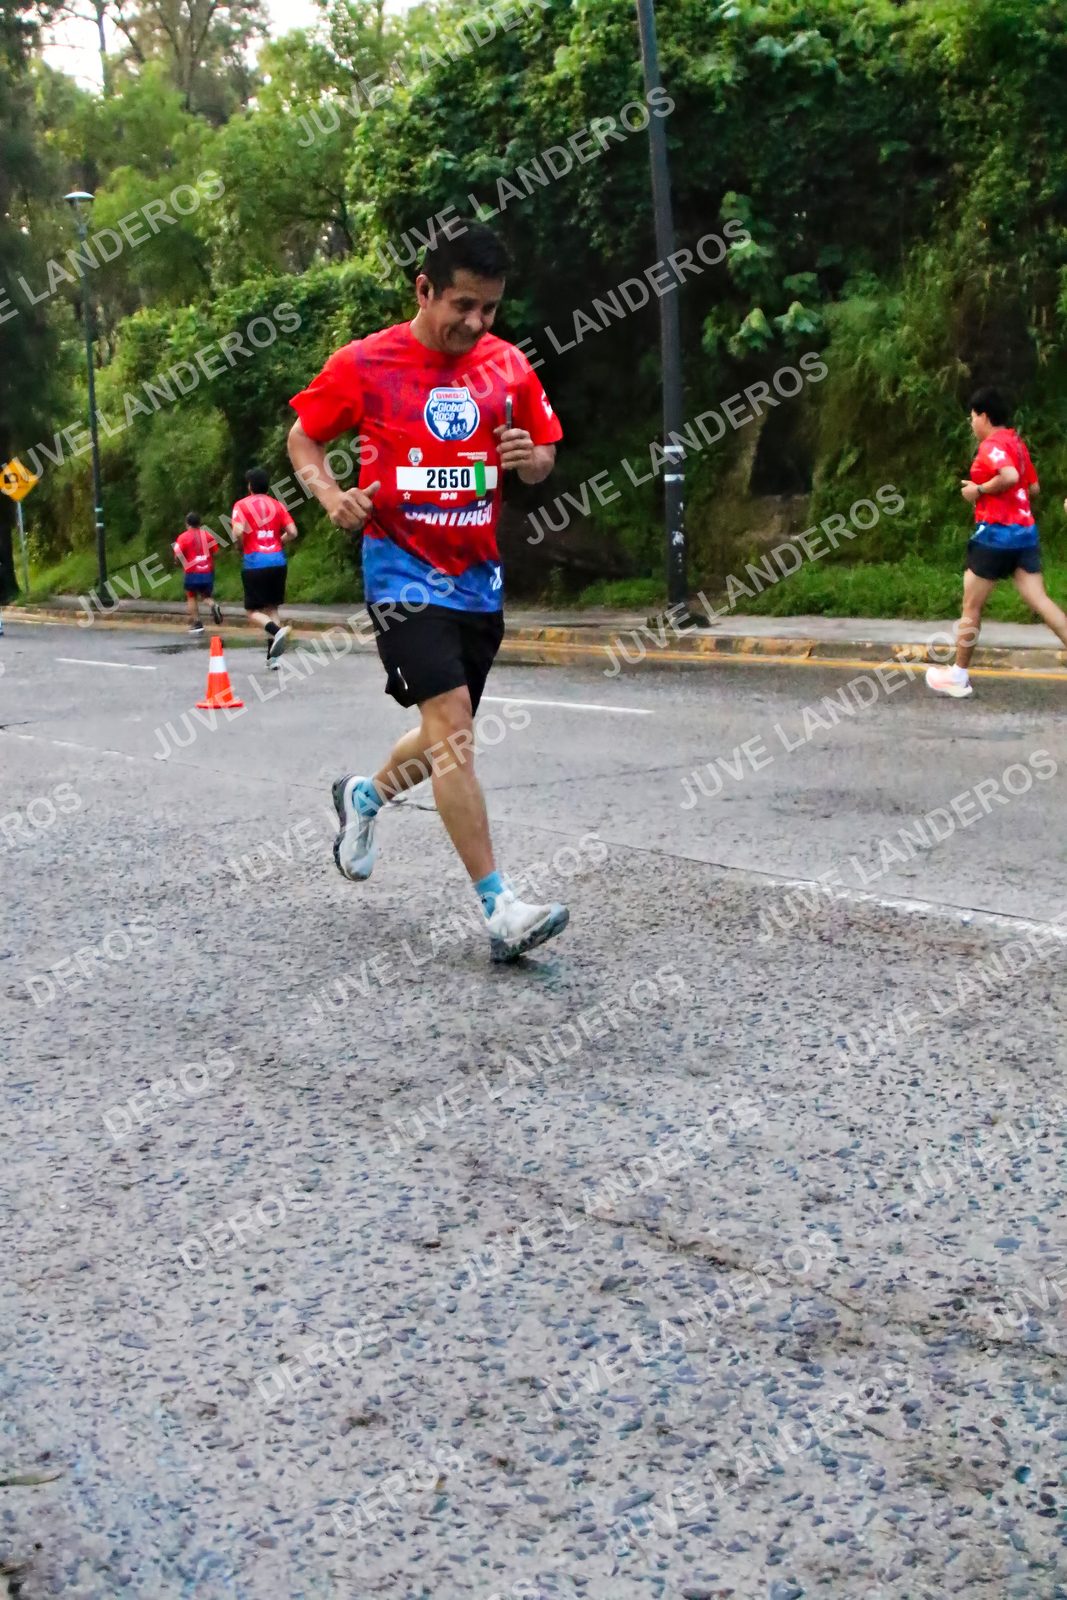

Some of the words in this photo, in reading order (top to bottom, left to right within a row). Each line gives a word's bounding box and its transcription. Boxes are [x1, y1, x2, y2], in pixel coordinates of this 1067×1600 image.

[435, 392, 465, 400] BIMBO
[437, 402, 466, 412] Global
[433, 412, 455, 421] Race
[426, 468, 471, 489] 2650
